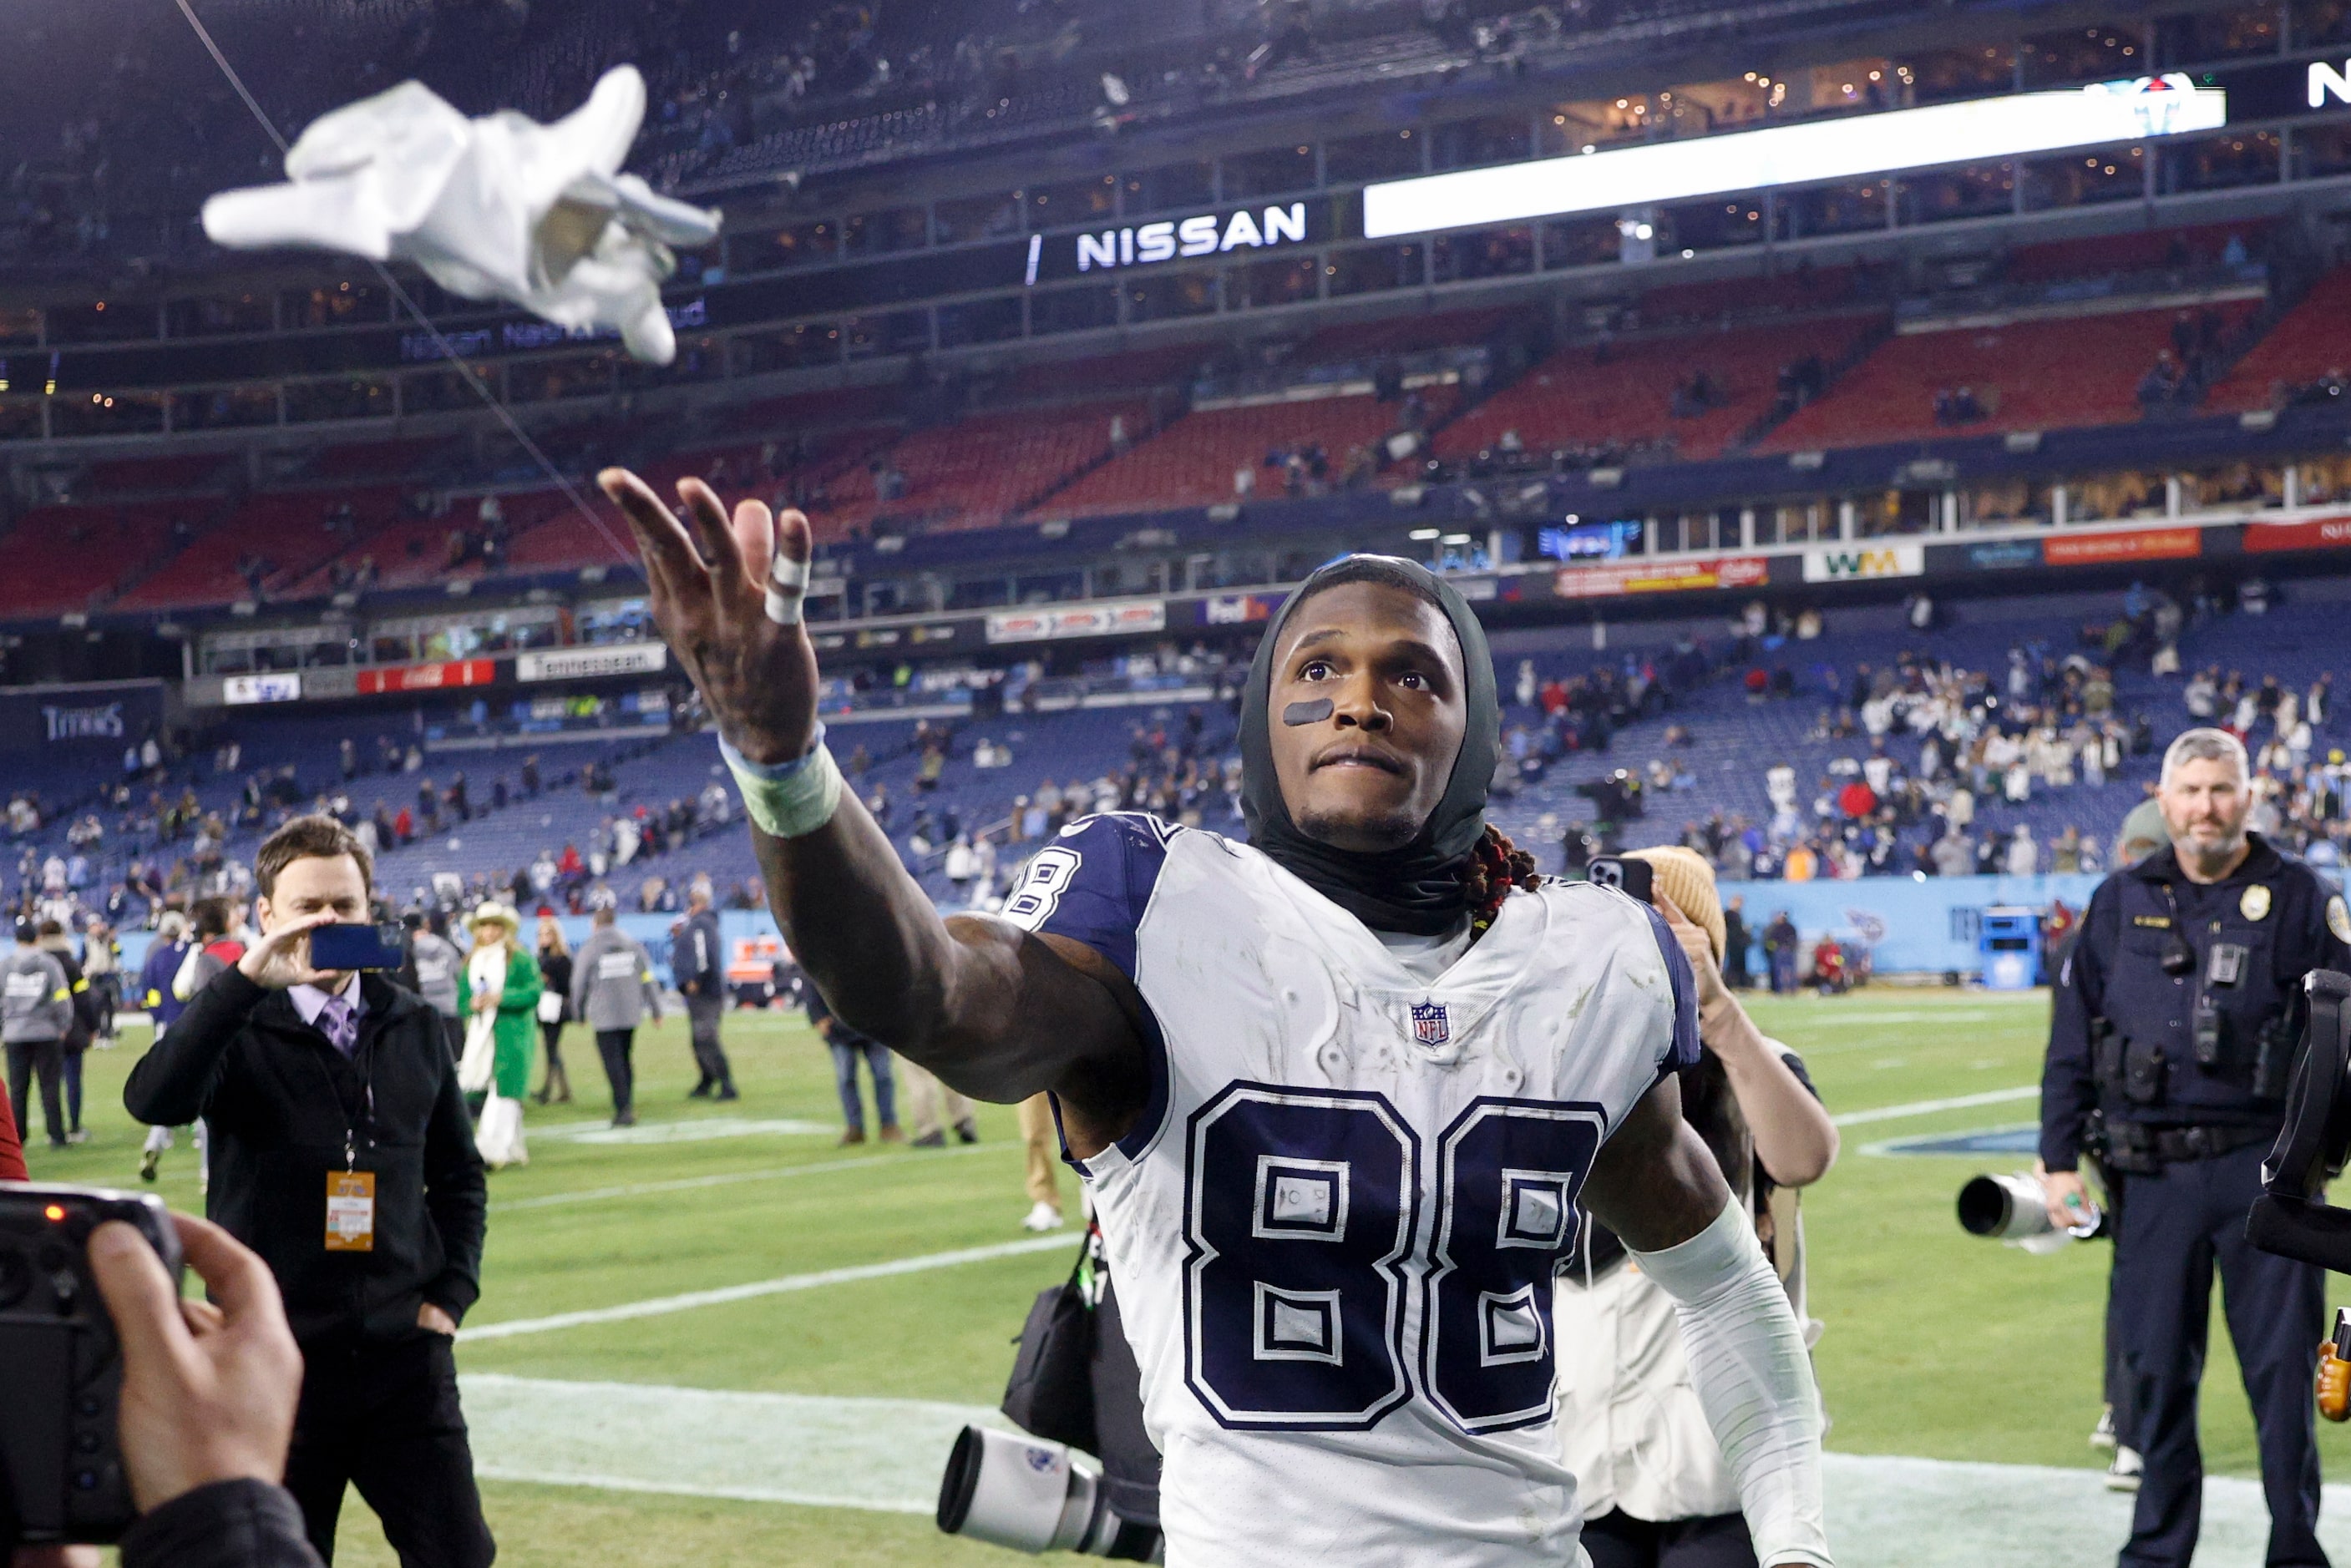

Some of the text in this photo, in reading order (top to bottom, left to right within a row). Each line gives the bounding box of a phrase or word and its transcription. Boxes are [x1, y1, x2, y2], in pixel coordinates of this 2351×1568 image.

[1077, 202, 1305, 271] NISSAN
[1826, 549, 1900, 577] WM
[1417, 1021, 1447, 1041] NFL
[1183, 1079, 1608, 1435] 88
